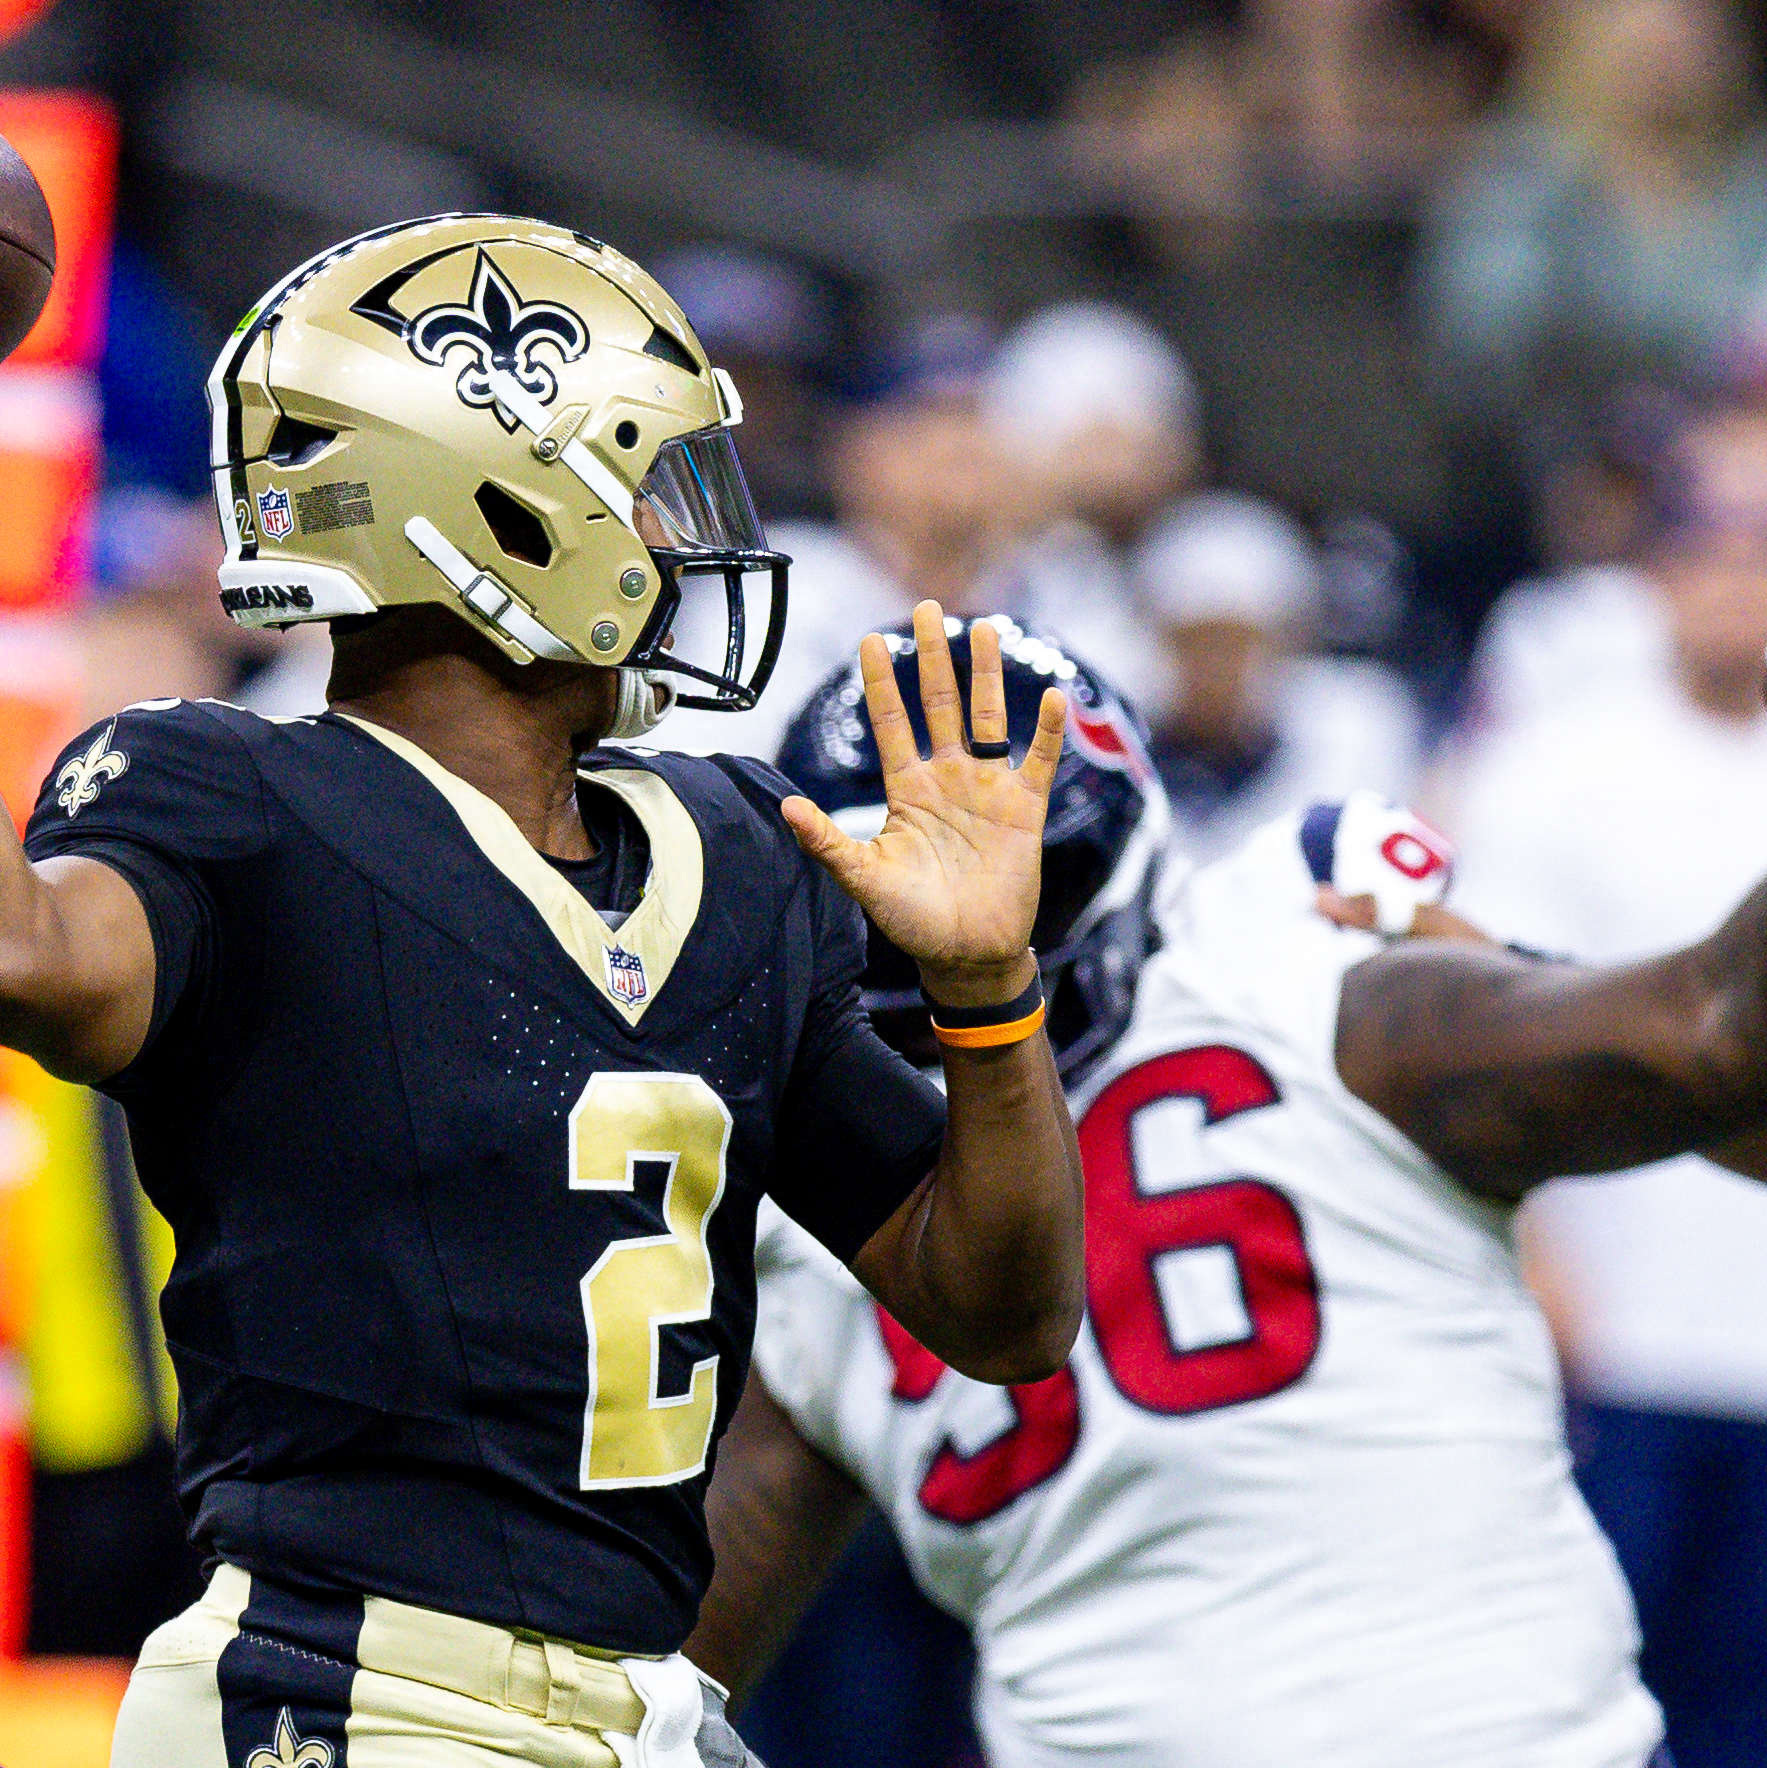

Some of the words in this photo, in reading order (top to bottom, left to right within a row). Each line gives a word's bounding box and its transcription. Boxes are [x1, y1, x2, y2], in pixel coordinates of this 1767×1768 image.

[234, 499, 257, 545] 2
[263, 510, 290, 533] NFL
[616, 969, 645, 996] NFL
[568, 1071, 735, 1492] 2
